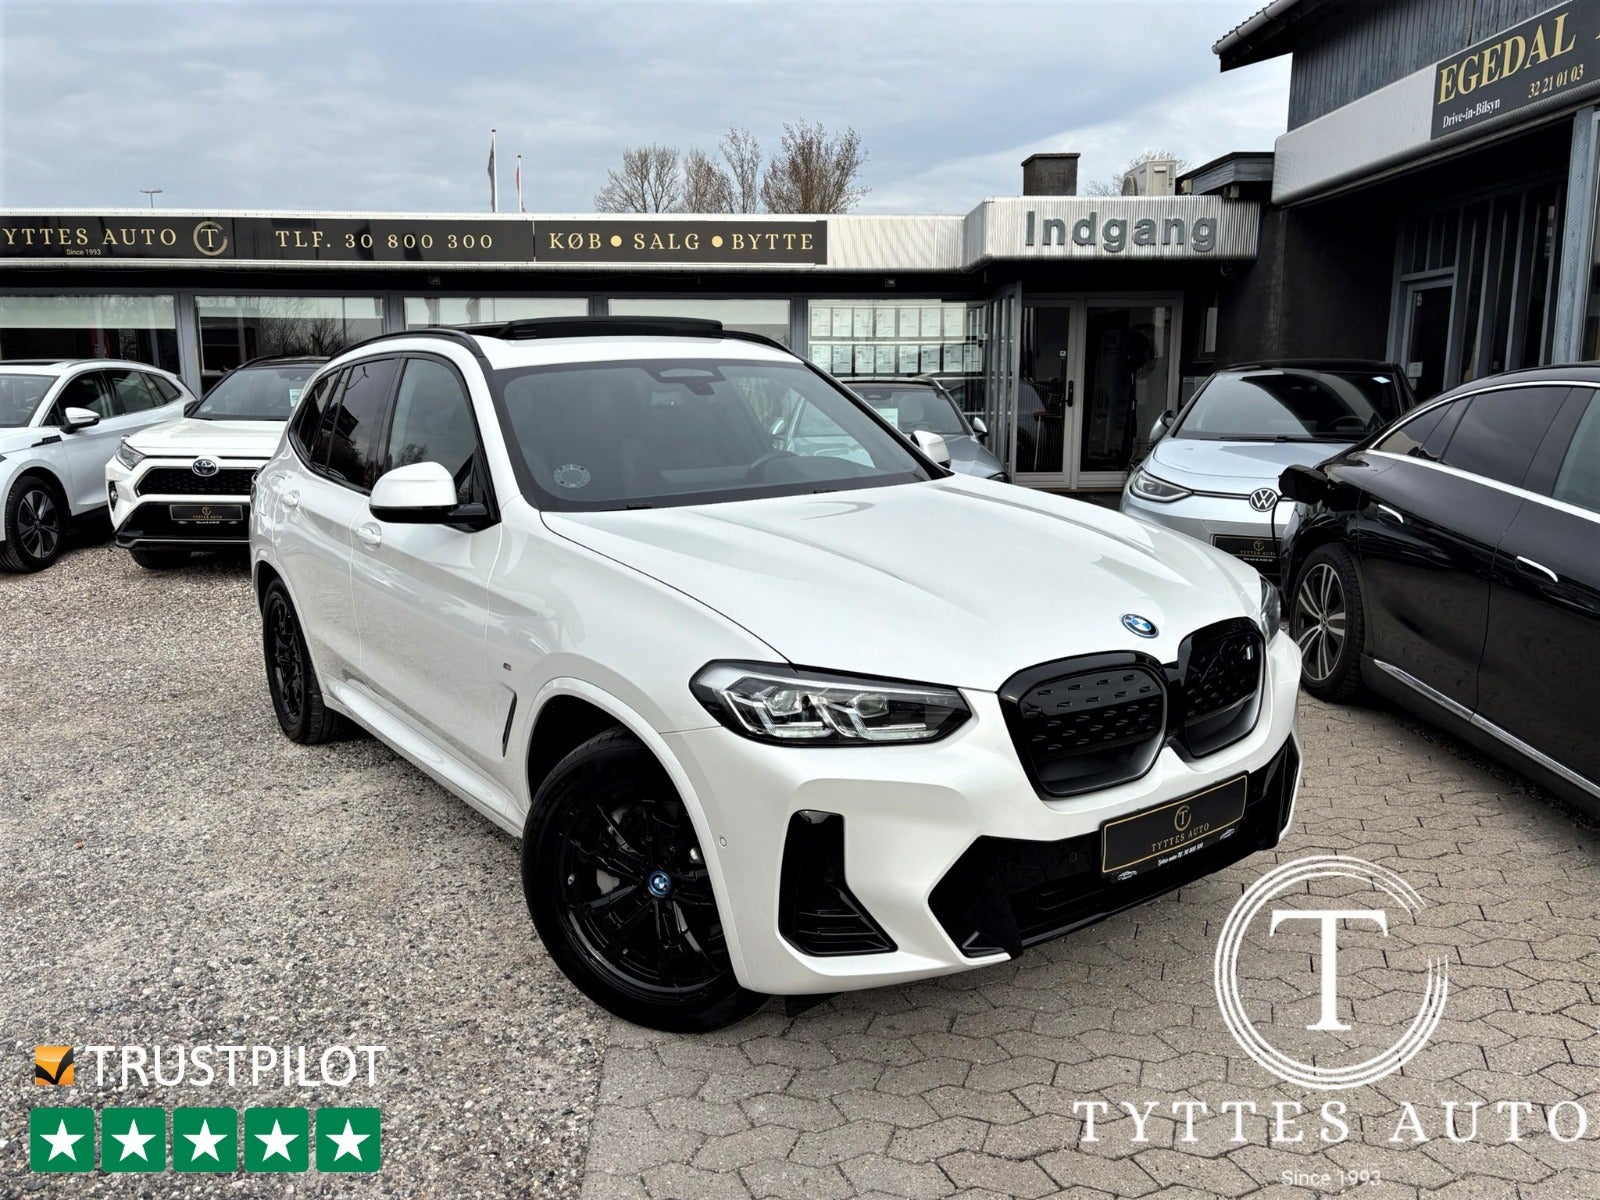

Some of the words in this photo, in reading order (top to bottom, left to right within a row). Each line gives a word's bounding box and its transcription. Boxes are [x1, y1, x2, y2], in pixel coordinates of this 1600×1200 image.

[1437, 12, 1577, 105] EGEDAL
[1528, 80, 1541, 99] 32
[1541, 75, 1554, 93] 21
[1556, 69, 1568, 88] 01
[1570, 63, 1584, 83] 03
[1442, 99, 1500, 129] Drive-in-Bilsyn
[1, 227, 89, 245] YTTES
[101, 228, 178, 246] AUTO
[275, 230, 331, 248] TLF.
[345, 233, 374, 249] 30
[387, 233, 434, 249] 800
[447, 234, 493, 249] 300
[549, 232, 602, 250] KØB
[633, 232, 700, 250] SALG
[731, 233, 814, 250] BYTTE
[1025, 211, 1218, 252] Indgang
[1151, 833, 1185, 852] TYTTES
[1188, 822, 1210, 839] AUTO
